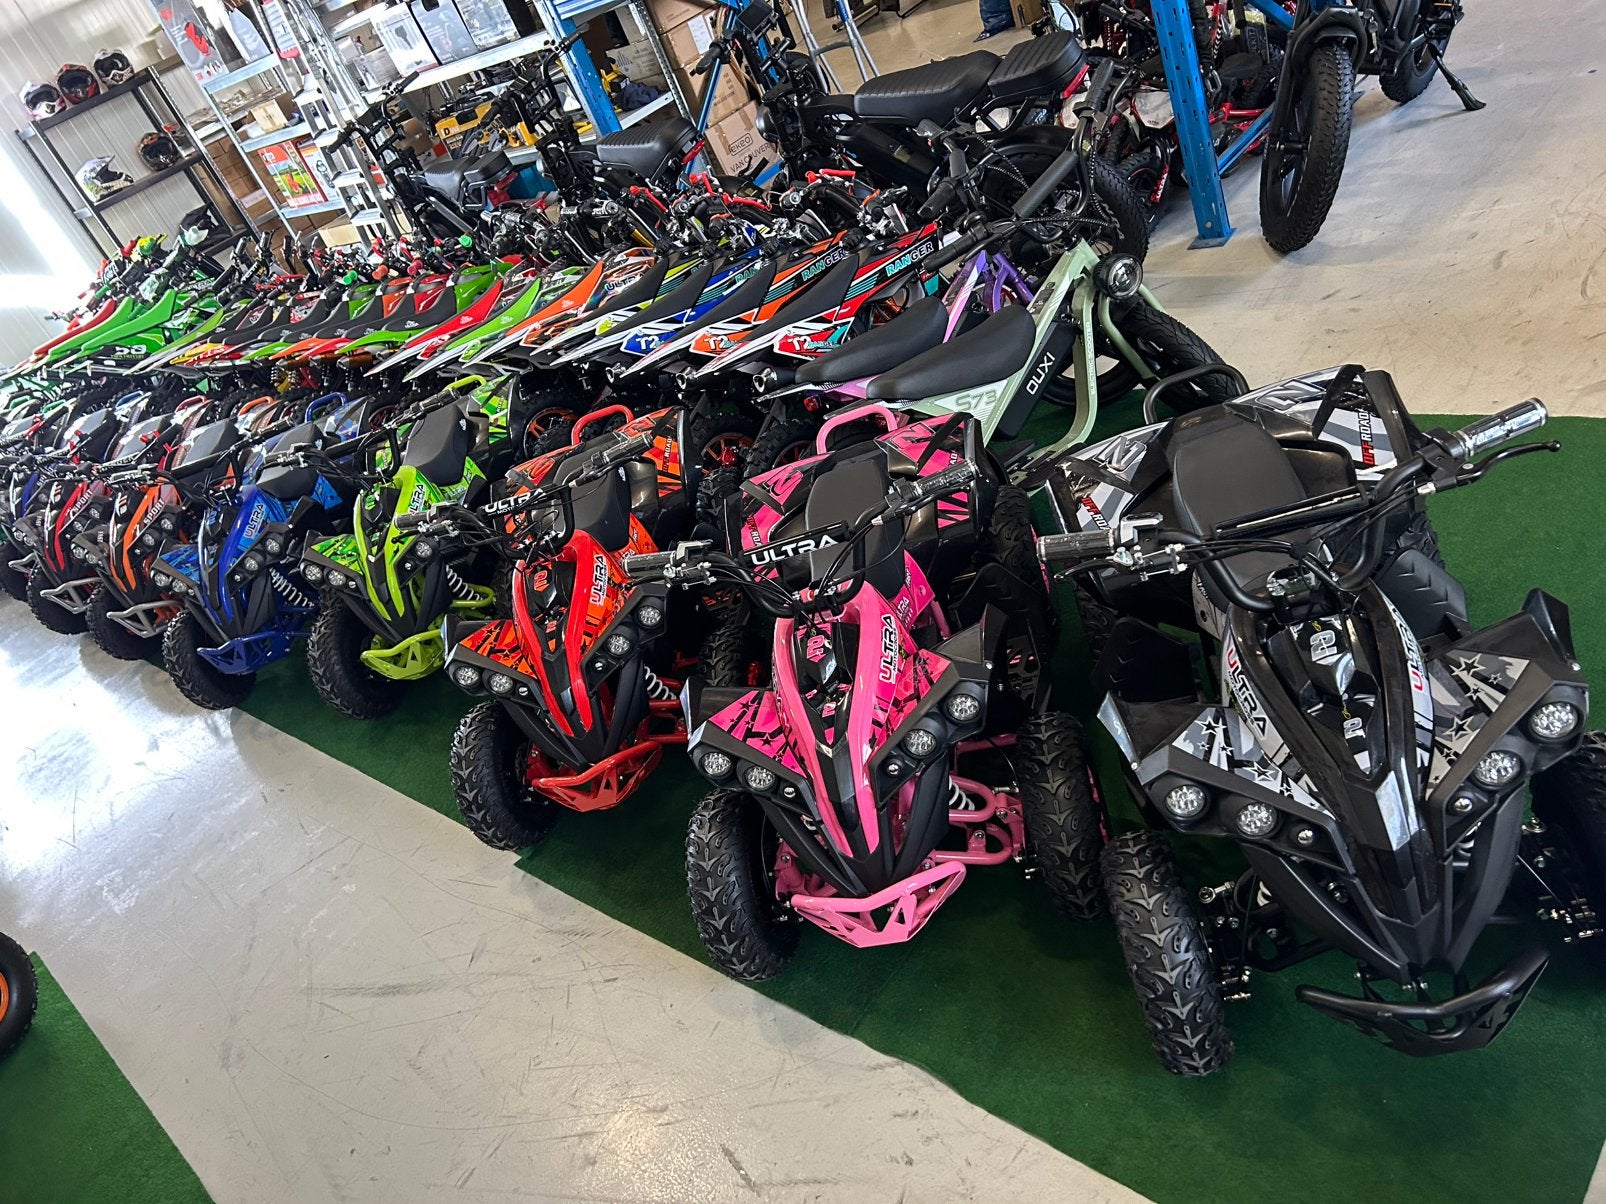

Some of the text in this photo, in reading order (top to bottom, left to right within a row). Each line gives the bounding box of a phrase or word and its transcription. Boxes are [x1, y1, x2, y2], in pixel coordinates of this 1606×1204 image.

[884, 241, 934, 277] RANGER
[636, 335, 660, 350] T2
[704, 335, 729, 350] T2
[787, 335, 811, 351] T2
[1026, 352, 1056, 395] OUXI
[955, 391, 998, 412] S73
[72, 489, 93, 513] SPORT
[144, 498, 164, 525] SPORT
[245, 504, 263, 538] ULTRA
[751, 534, 839, 566] ULTRA
[590, 555, 605, 606] ULTRA
[880, 615, 898, 682] ULTRA
[1226, 647, 1268, 740] ULTRA
